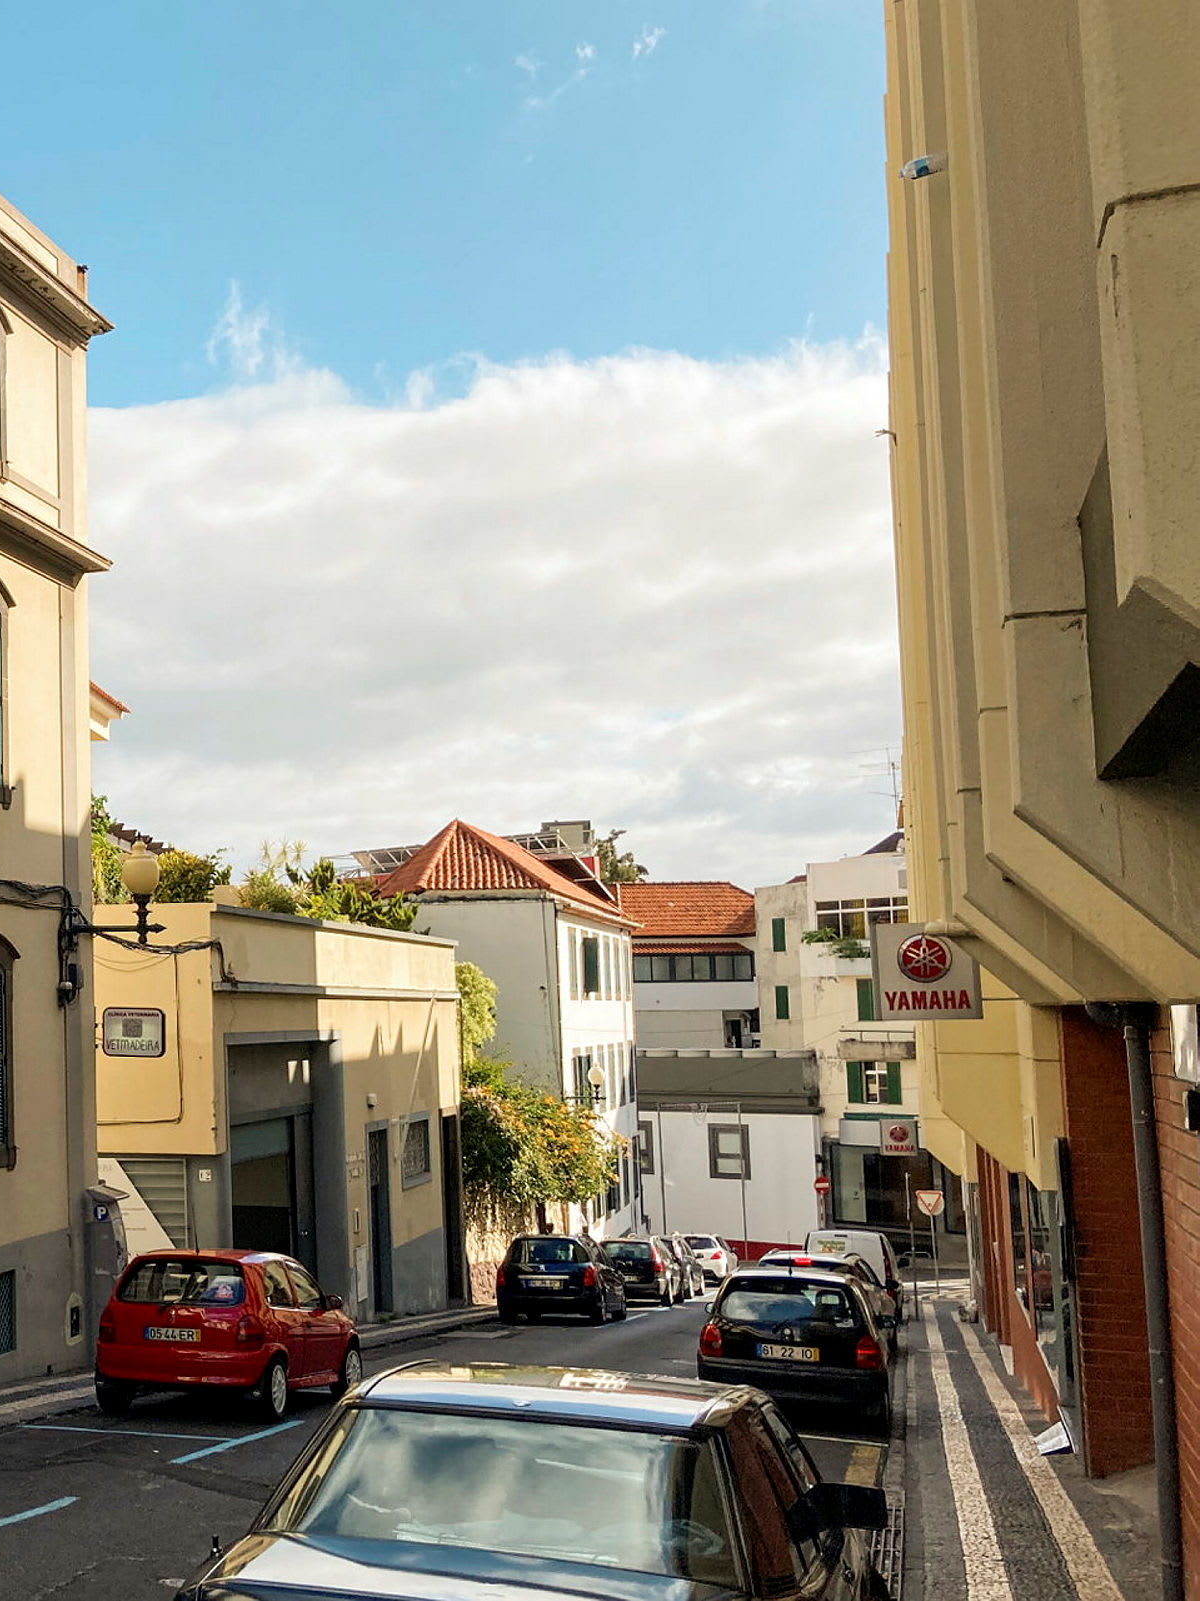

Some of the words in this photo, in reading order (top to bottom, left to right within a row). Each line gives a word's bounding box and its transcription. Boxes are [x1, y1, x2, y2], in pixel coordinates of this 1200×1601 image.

[884, 989, 972, 1011] YAMAHA
[106, 1038, 160, 1052] VETMADEIRA
[96, 1206, 107, 1220] P
